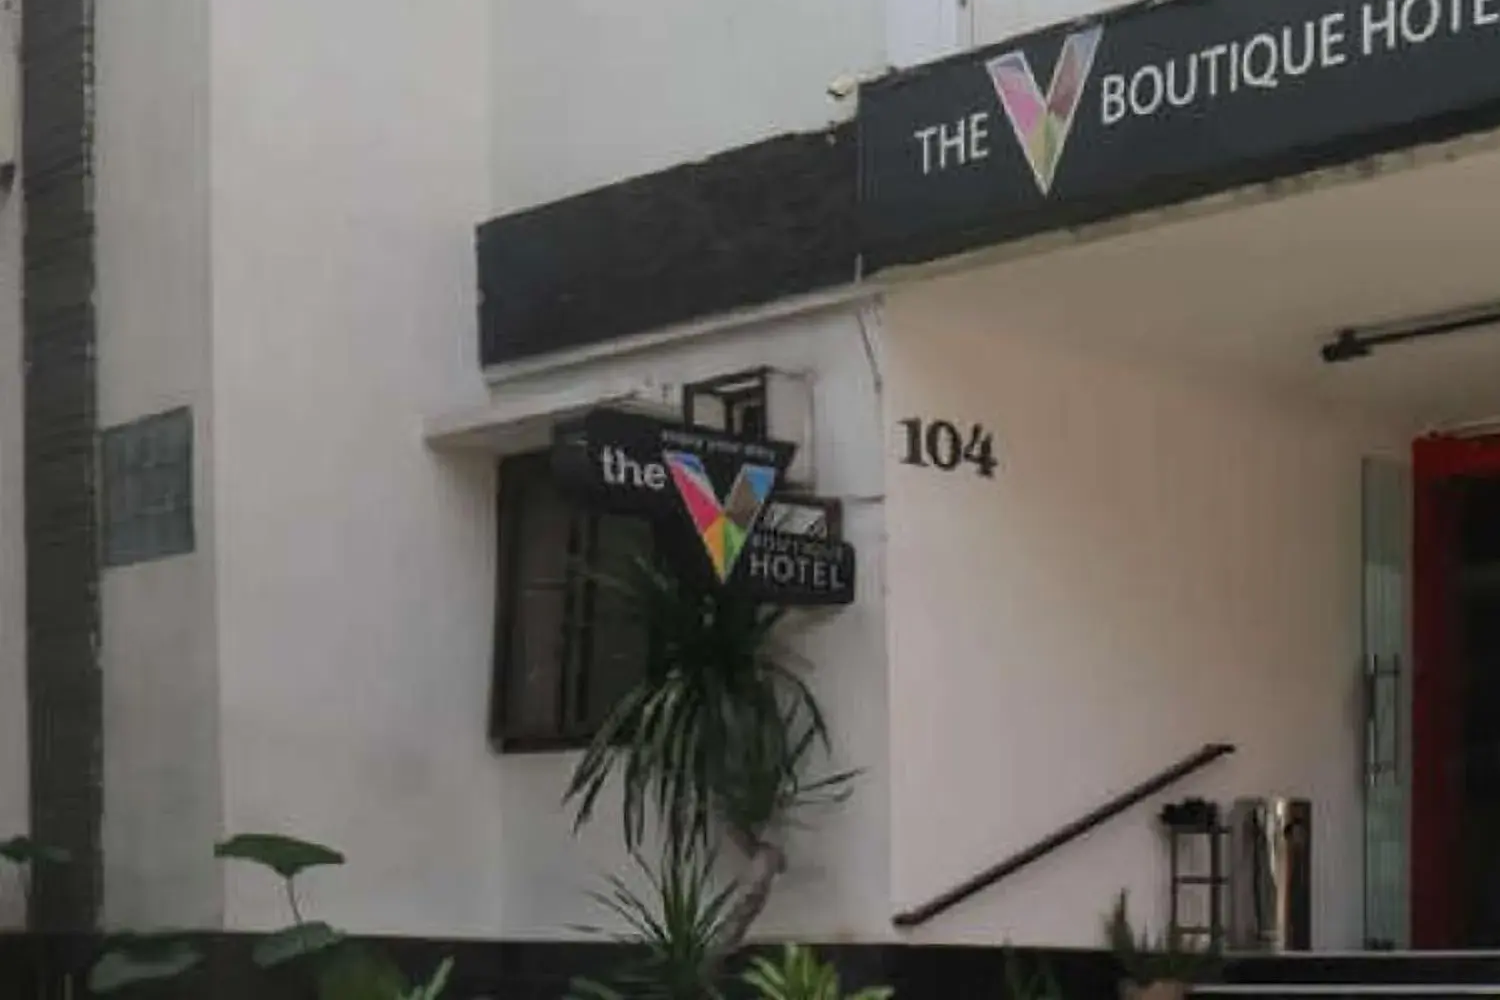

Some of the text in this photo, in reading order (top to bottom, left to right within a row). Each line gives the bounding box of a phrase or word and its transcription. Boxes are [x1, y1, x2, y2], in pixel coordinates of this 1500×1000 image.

[914, 112, 988, 174] THE
[986, 25, 1102, 197] V
[1101, 13, 1347, 123] BOUTIQUE
[897, 418, 998, 479] 104
[602, 445, 776, 585] the V
[750, 553, 845, 588] HOTEL
